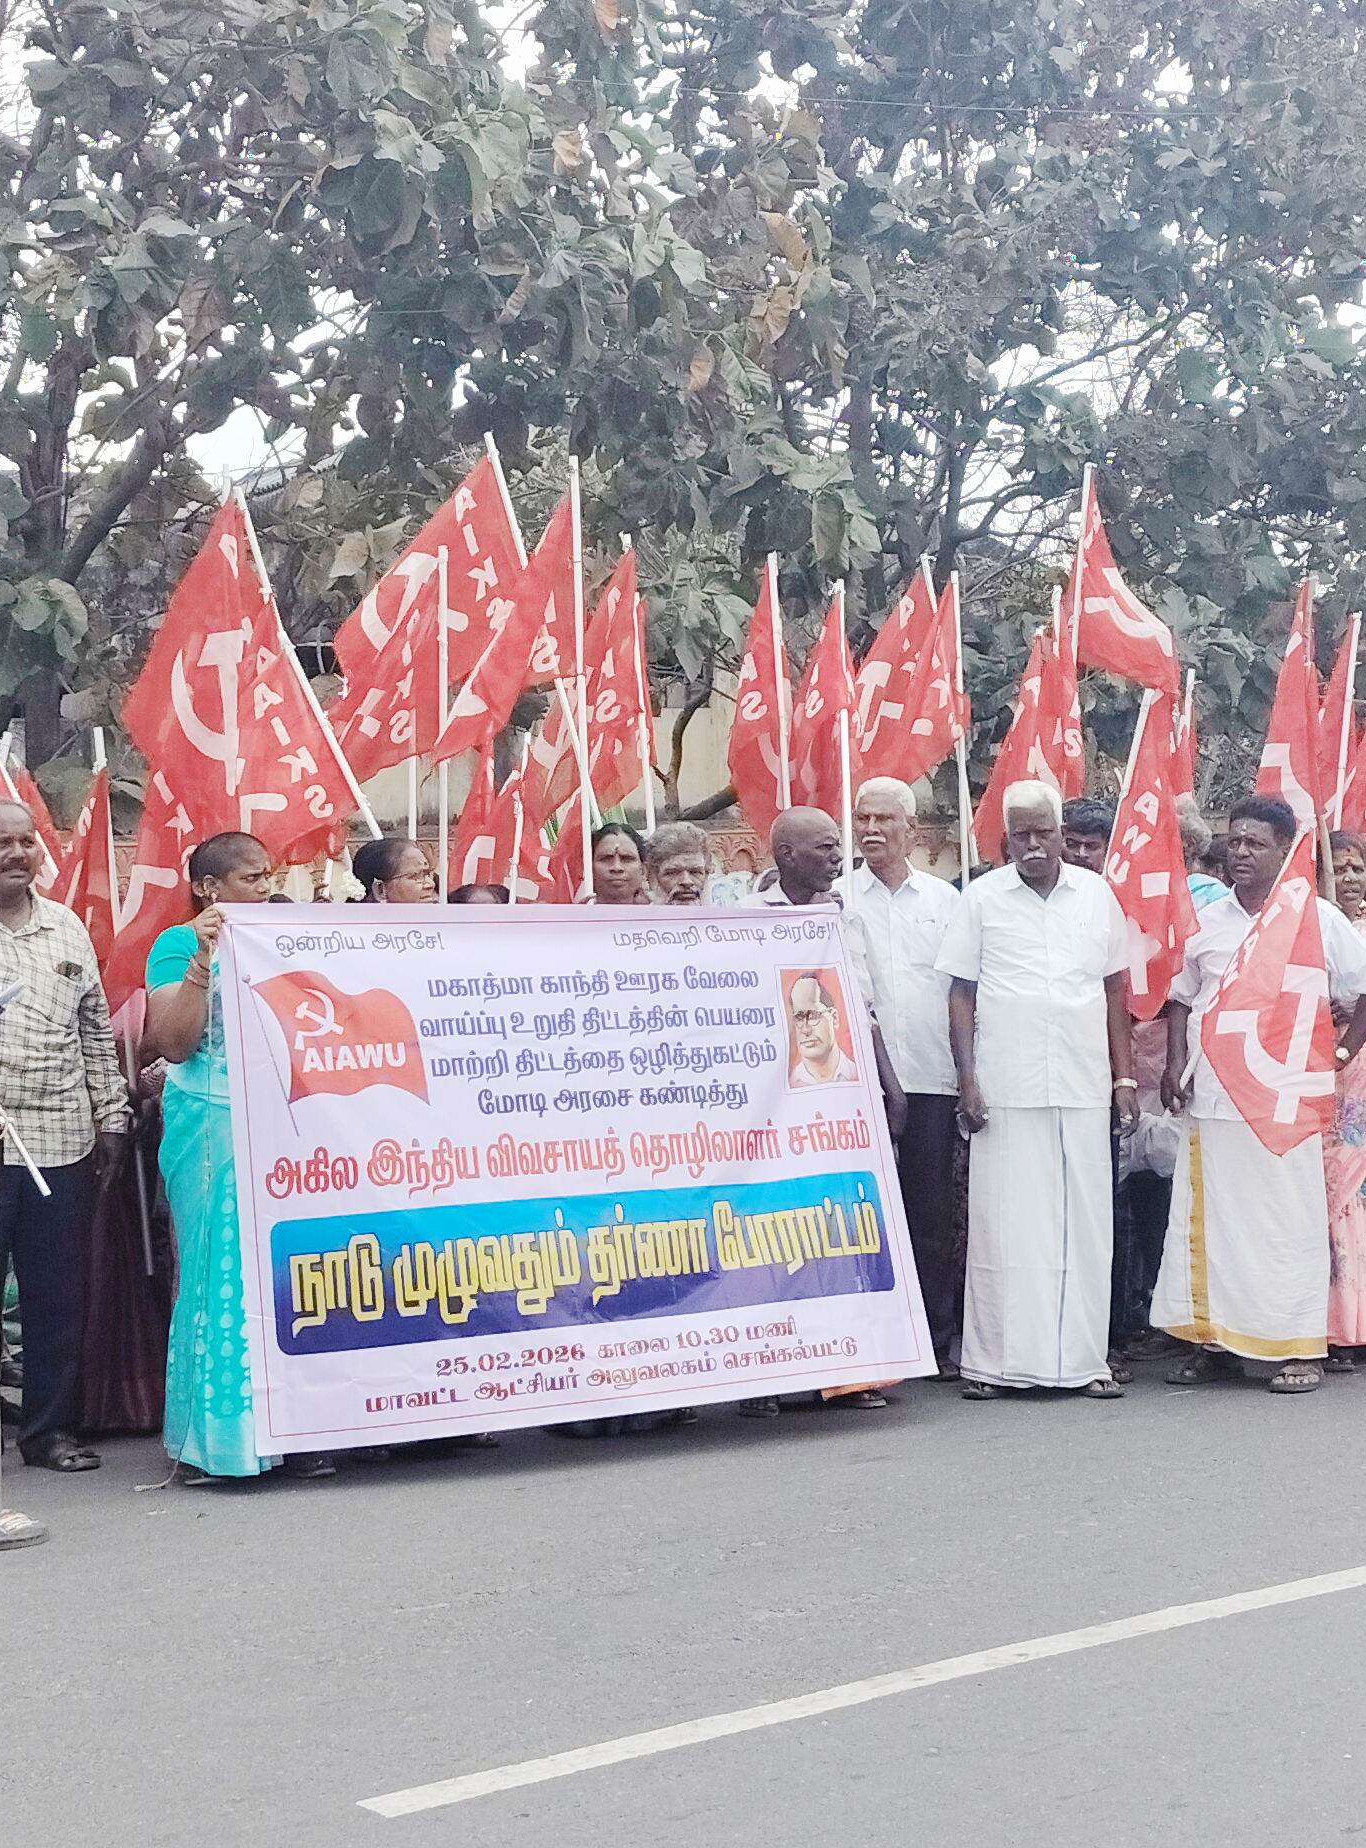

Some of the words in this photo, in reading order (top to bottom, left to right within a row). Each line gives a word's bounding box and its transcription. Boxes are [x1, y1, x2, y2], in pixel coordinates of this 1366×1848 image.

[275, 930, 366, 957] ஒன்றிய
[372, 930, 445, 953] அரசே!
[613, 925, 702, 951] மதவெறி
[706, 924, 767, 946] மோடி
[427, 971, 533, 1002] மகாத்மா
[540, 970, 609, 999] காந்தி
[614, 971, 680, 995] ஊரக
[683, 965, 759, 990] வேலை
[420, 1009, 507, 1040] வாய்ப்பு
[512, 1007, 576, 1040] உறுதி
[582, 1004, 689, 1037] திட்டத்தின்
[695, 1005, 776, 1029] பெயரை
[303, 1042, 407, 1073] AIAWU
[430, 1048, 510, 1083] மாற்றி
[515, 1045, 625, 1080] திட்டத்தை
[629, 1038, 777, 1075] ஒழித்துகட்டும்
[478, 1088, 547, 1118] மோடி
[553, 1088, 633, 1113] அரசை
[639, 1078, 749, 1111] கண்டித்து
[266, 1146, 358, 1199] அகில
[367, 1137, 480, 1197] இந்திய
[486, 1126, 625, 1184] விவசாயத்
[629, 1118, 782, 1179] தொழிலாளர்
[788, 1109, 871, 1156] சங்கம்
[289, 1233, 385, 1339] நாடு
[392, 1207, 582, 1325] முழுவதும்
[587, 1203, 710, 1307] தர்ணா
[712, 1181, 881, 1276] போராட்டம்
[436, 1343, 586, 1377] 25.02.2026
[598, 1337, 671, 1360] காலை
[676, 1326, 740, 1351] 10.30
[746, 1315, 798, 1341] மணி
[365, 1387, 470, 1412] மாவட்ட
[473, 1367, 580, 1402] ஆட்சியர்
[586, 1350, 717, 1390] அலுவலகம்
[723, 1336, 858, 1370] செங்கல்பட்டு
